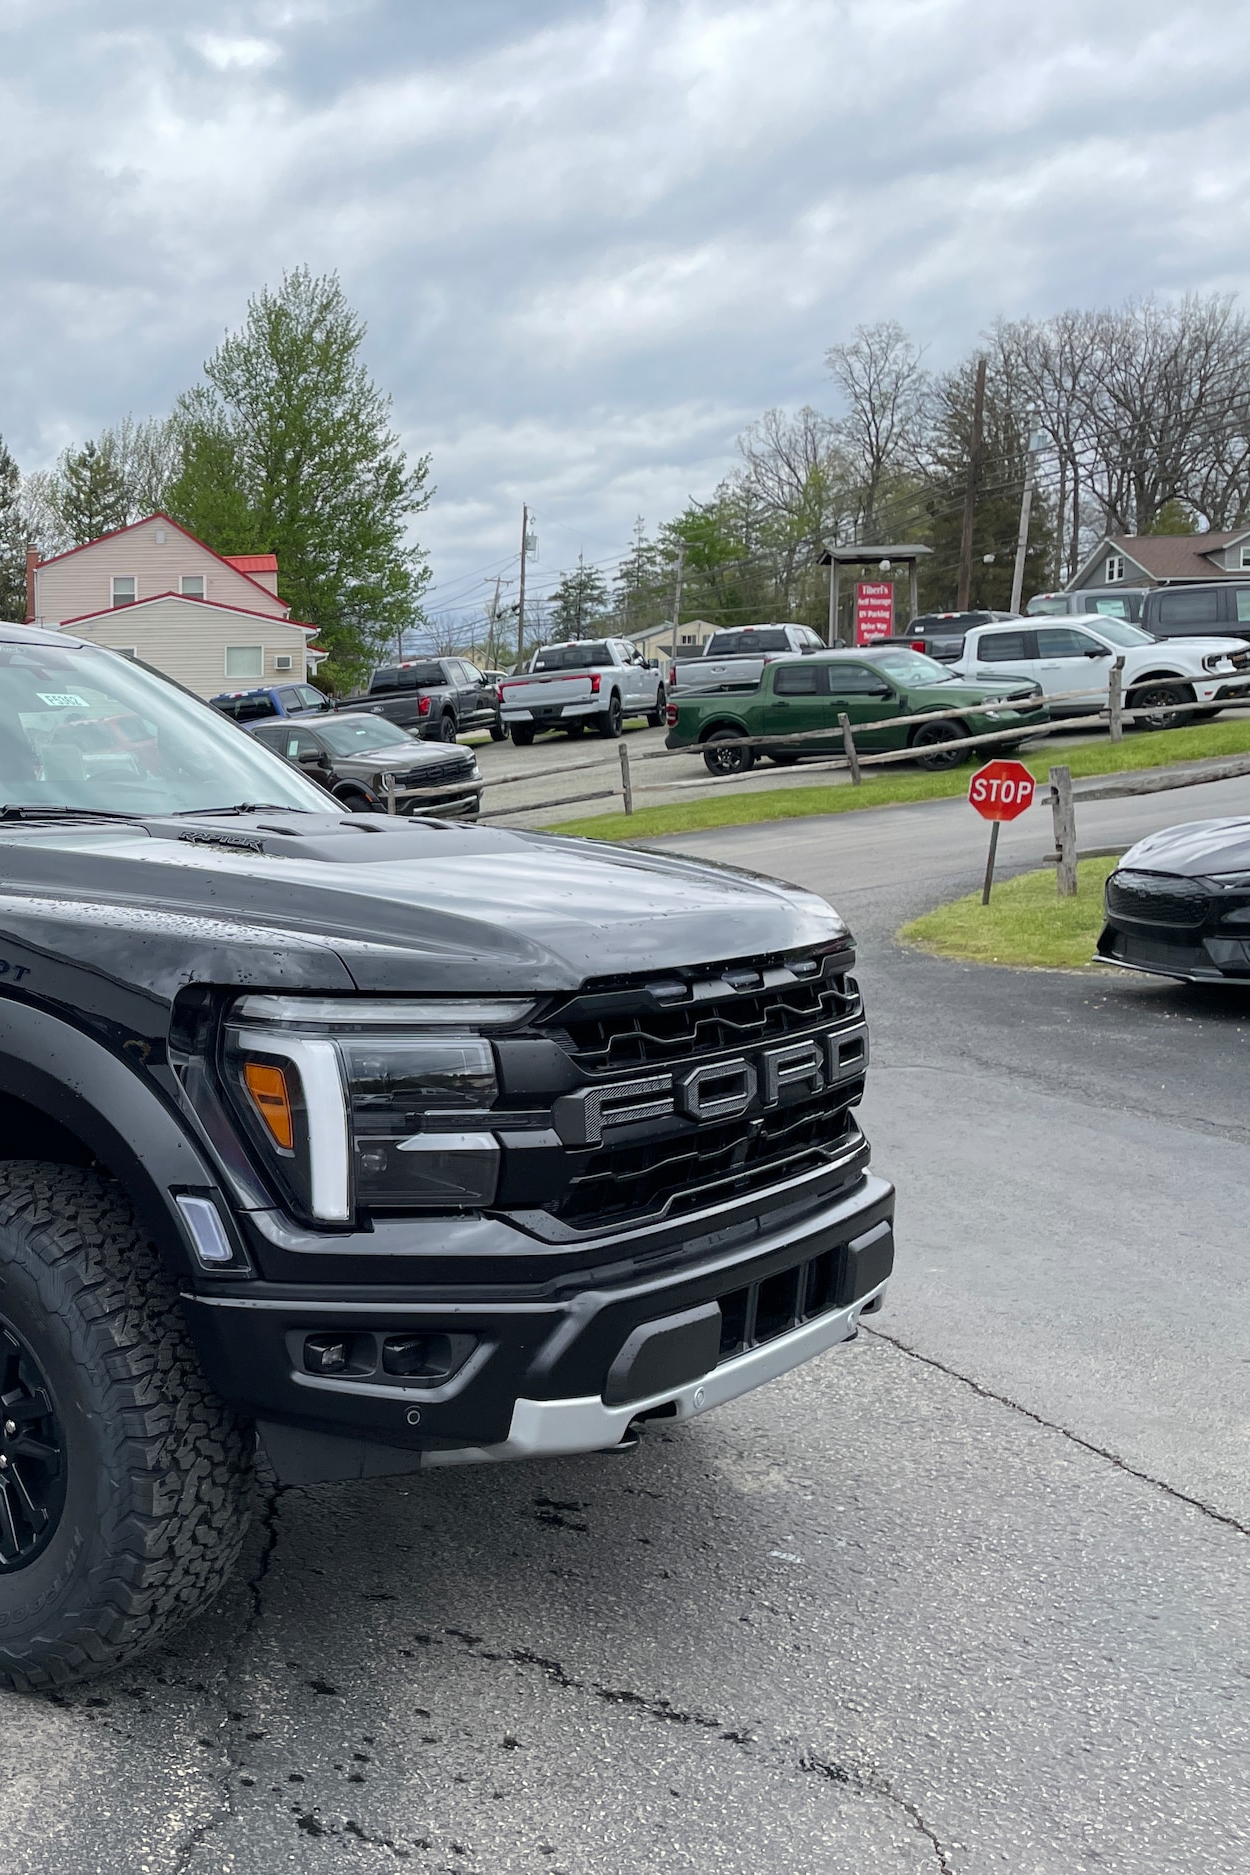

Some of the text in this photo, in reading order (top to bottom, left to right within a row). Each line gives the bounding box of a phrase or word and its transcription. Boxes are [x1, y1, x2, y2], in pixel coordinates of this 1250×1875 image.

[868, 610, 889, 619] Parking
[972, 778, 1032, 804] STOP
[178, 830, 267, 854] RAPTOR
[582, 1020, 869, 1144] FORD
